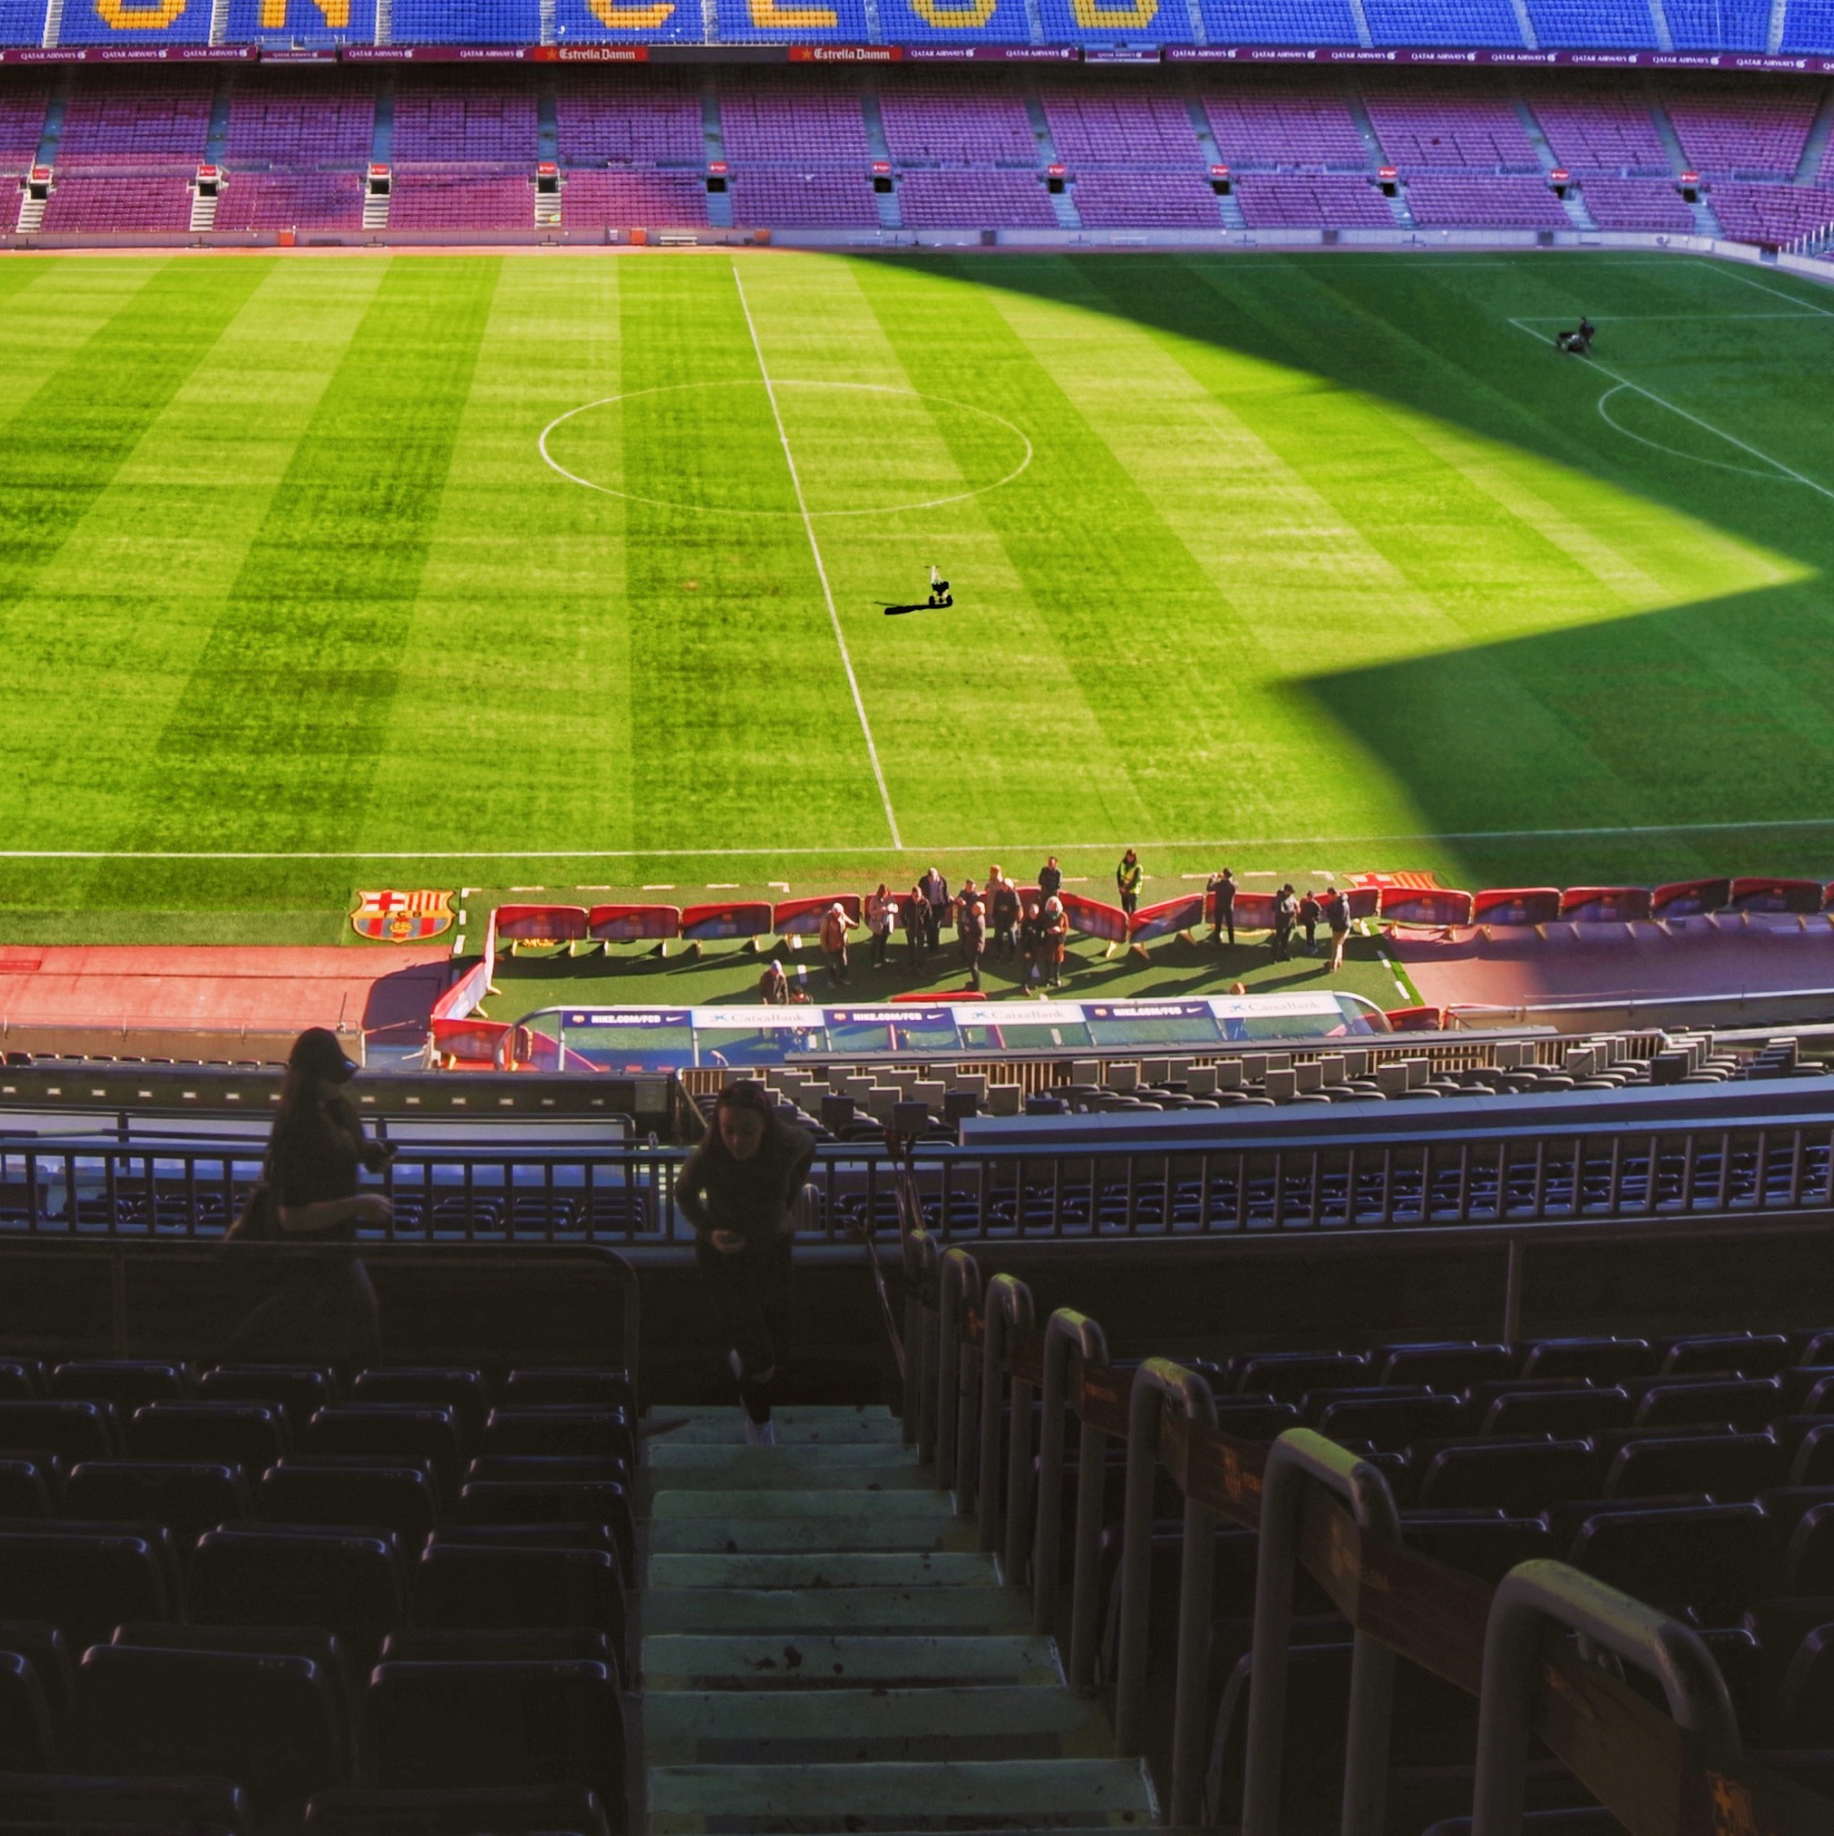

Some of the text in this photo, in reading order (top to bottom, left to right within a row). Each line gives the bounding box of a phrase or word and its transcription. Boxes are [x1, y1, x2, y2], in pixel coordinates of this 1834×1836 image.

[558, 48, 635, 60] Estrella Damm
[814, 48, 890, 59] Estrella Damm
